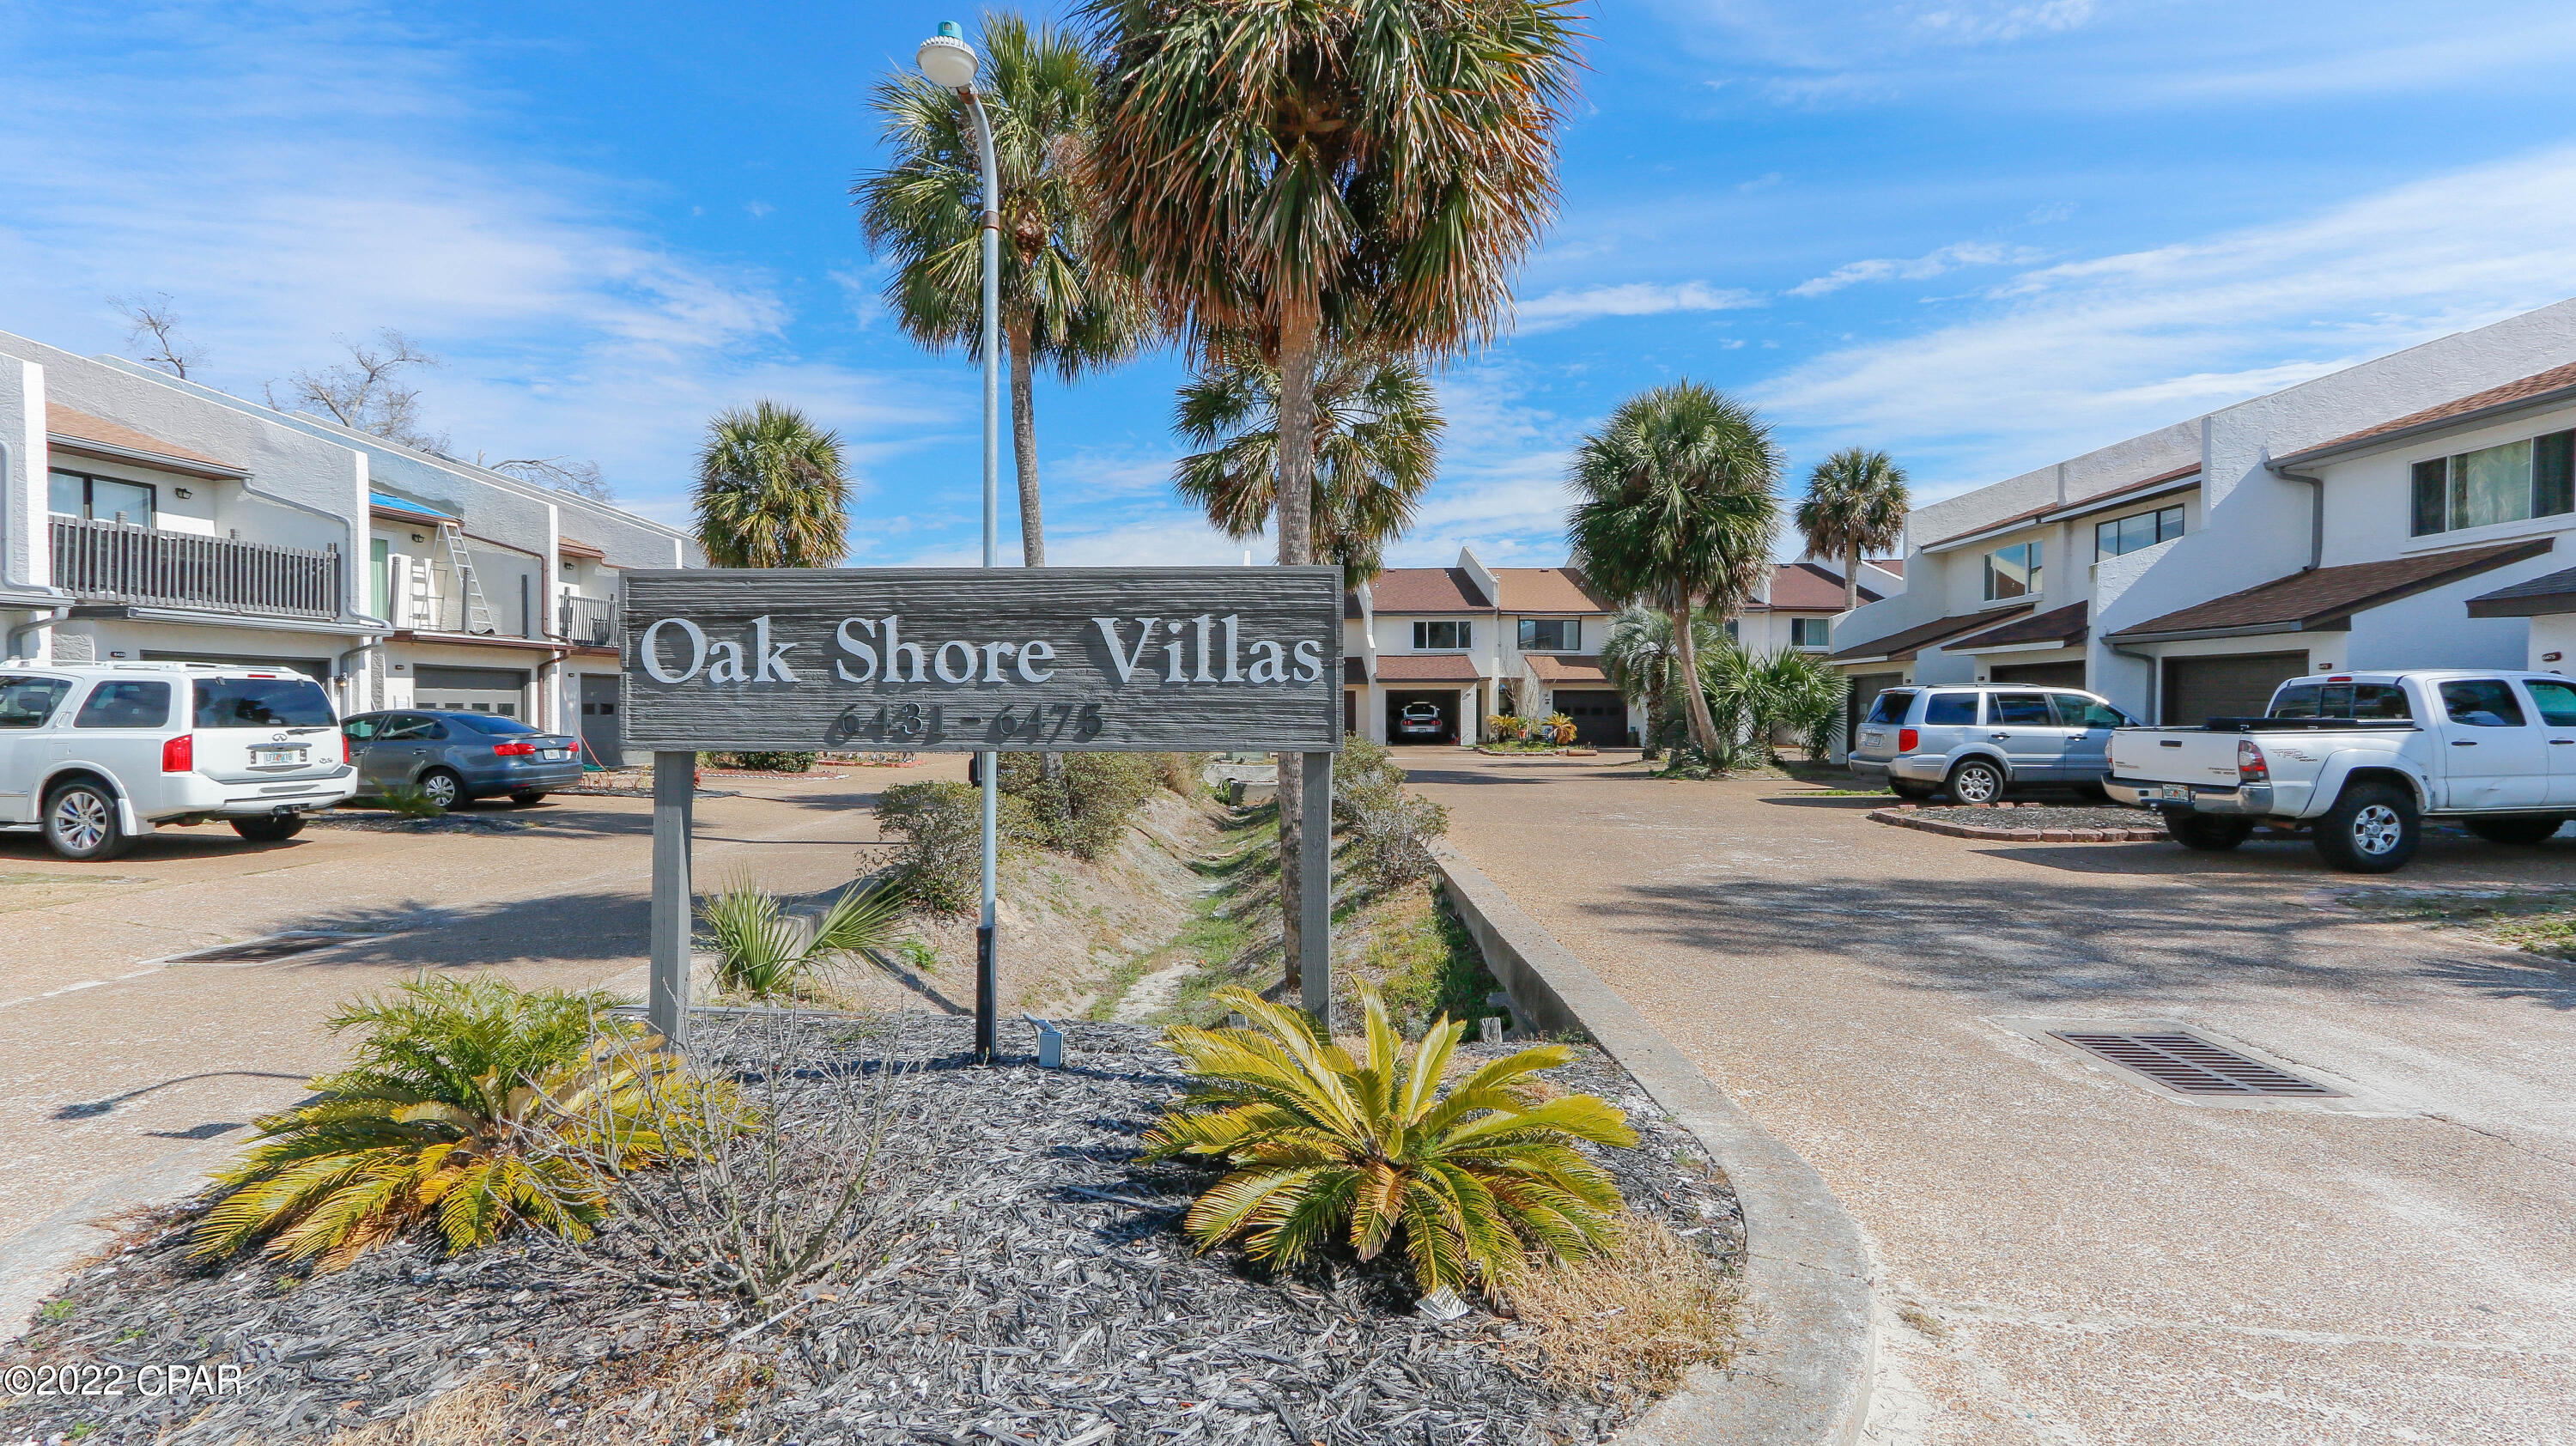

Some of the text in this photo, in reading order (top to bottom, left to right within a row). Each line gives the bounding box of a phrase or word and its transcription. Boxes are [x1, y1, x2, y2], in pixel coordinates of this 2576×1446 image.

[641, 613, 1321, 684] Oak Shore Villas
